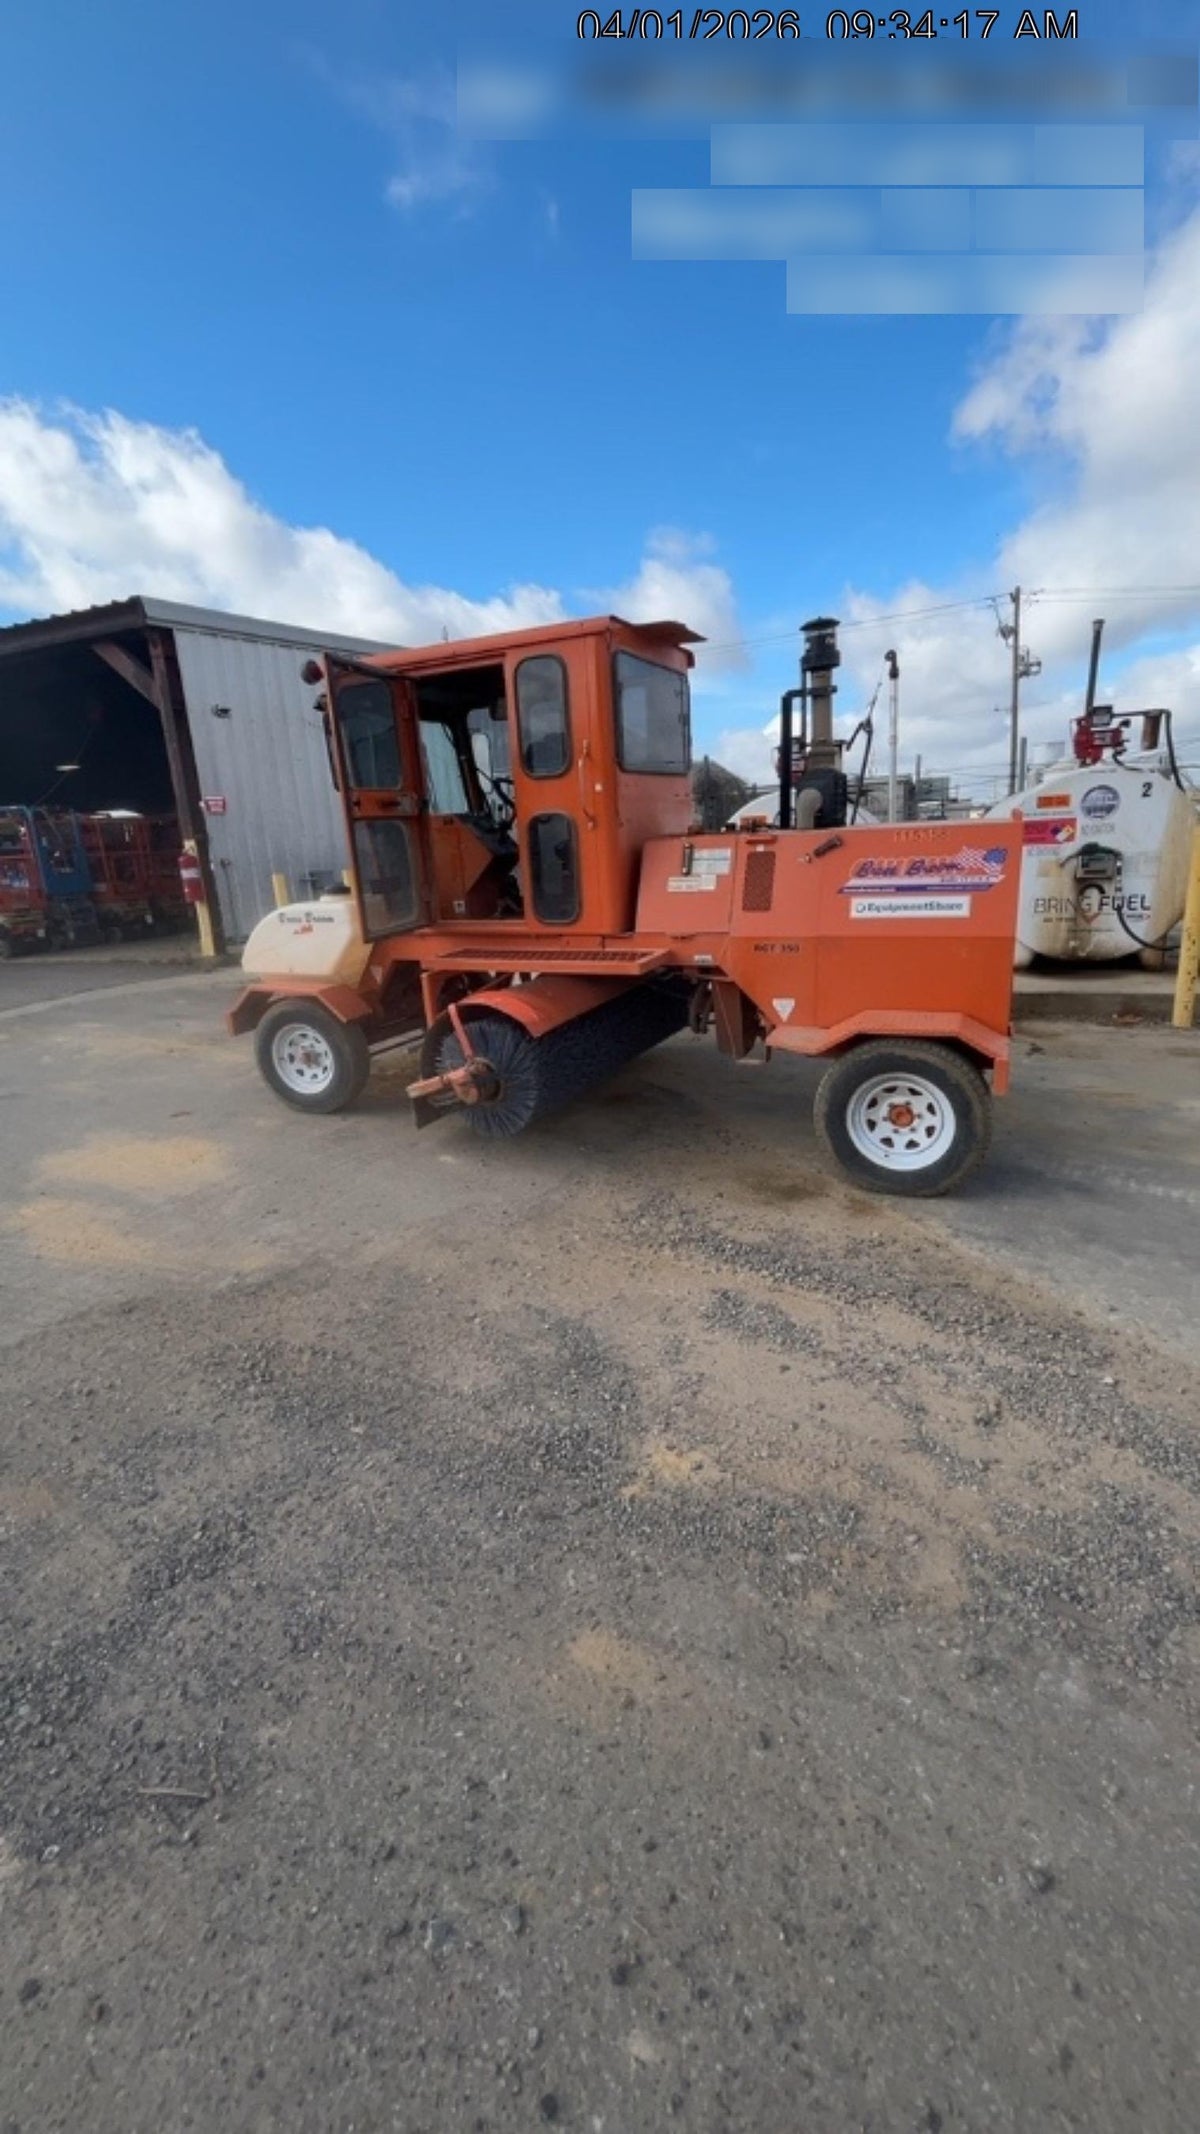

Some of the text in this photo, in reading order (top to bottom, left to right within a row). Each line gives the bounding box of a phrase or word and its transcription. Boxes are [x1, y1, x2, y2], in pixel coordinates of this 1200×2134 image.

[1142, 783, 1153, 797] 2
[1034, 894, 1151, 914] BRING FUEL
